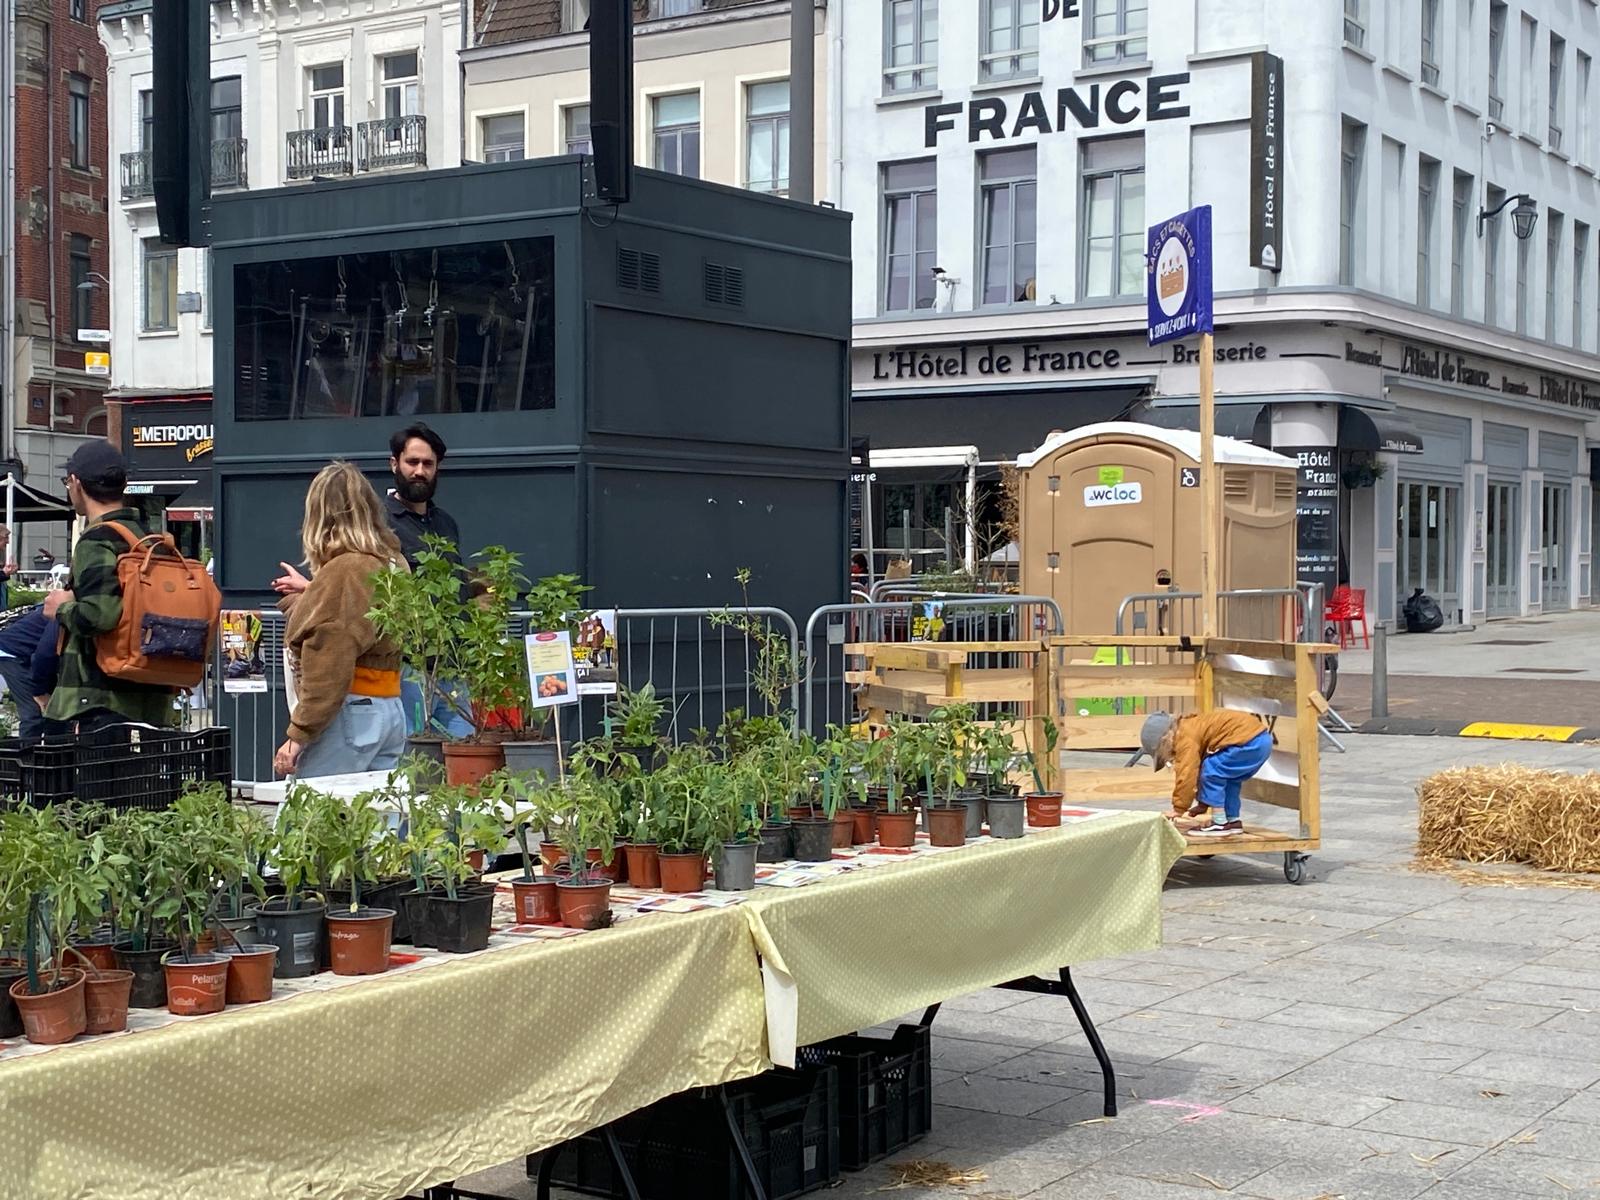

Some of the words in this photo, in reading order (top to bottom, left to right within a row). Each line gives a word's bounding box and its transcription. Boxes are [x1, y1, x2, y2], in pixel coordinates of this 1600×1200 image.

[1042, 0, 1079, 22] DE
[925, 72, 1190, 147] FRANCE
[1265, 73, 1275, 137] France
[1265, 145, 1275, 169] de
[1265, 177, 1274, 228] Hôtel
[873, 347, 968, 379] L'Hôtel
[978, 346, 1012, 374] de
[1022, 344, 1120, 372] France
[1172, 342, 1266, 363] Braserie
[1442, 353, 1455, 382] de
[141, 425, 214, 442] METROPOLI
[1297, 451, 1331, 466] Hôtel
